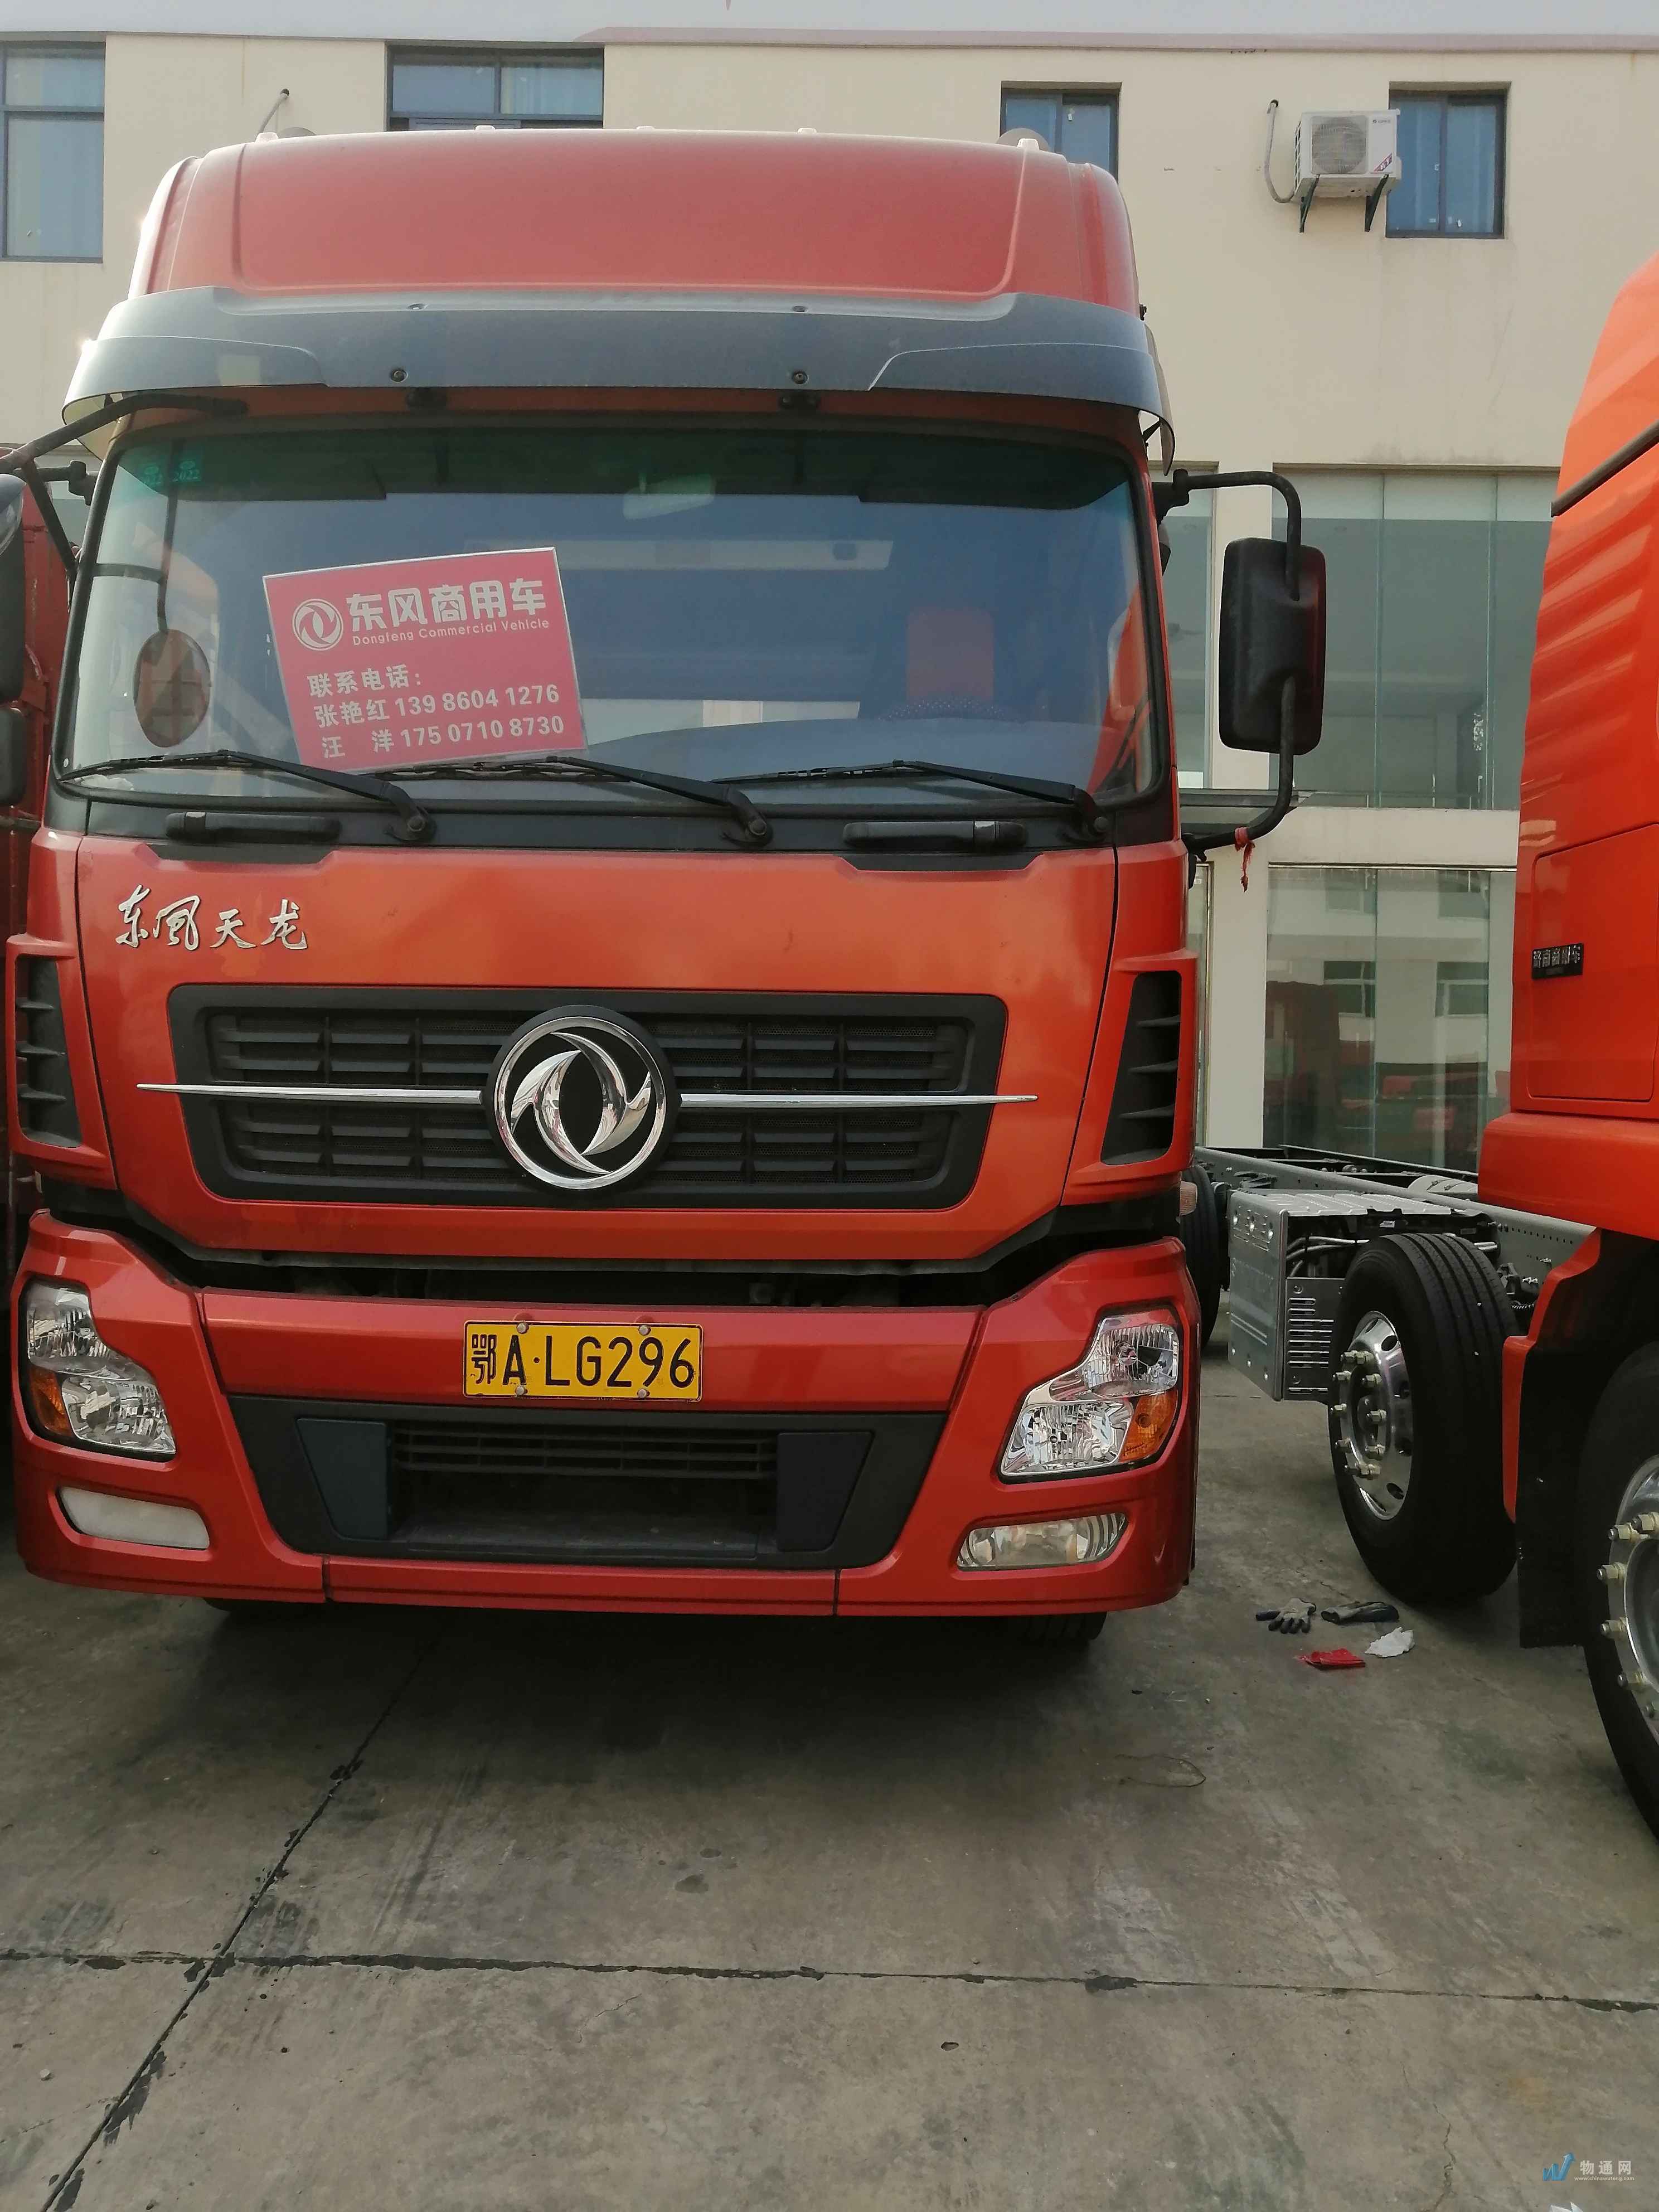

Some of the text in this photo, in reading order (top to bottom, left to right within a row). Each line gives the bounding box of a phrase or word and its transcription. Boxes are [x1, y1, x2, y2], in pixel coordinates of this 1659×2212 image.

[346, 578, 546, 632] 东风商用车
[352, 618, 549, 647] Dongfeng Commercial Vehicle
[313, 684, 560, 729] 张艳红 139 8604 1276
[400, 726, 442, 748] 175
[448, 719, 503, 743] 0710
[508, 715, 564, 737] 8730
[115, 884, 307, 951] 东风天龙
[470, 1334, 697, 1388] 鄂A·LG296
